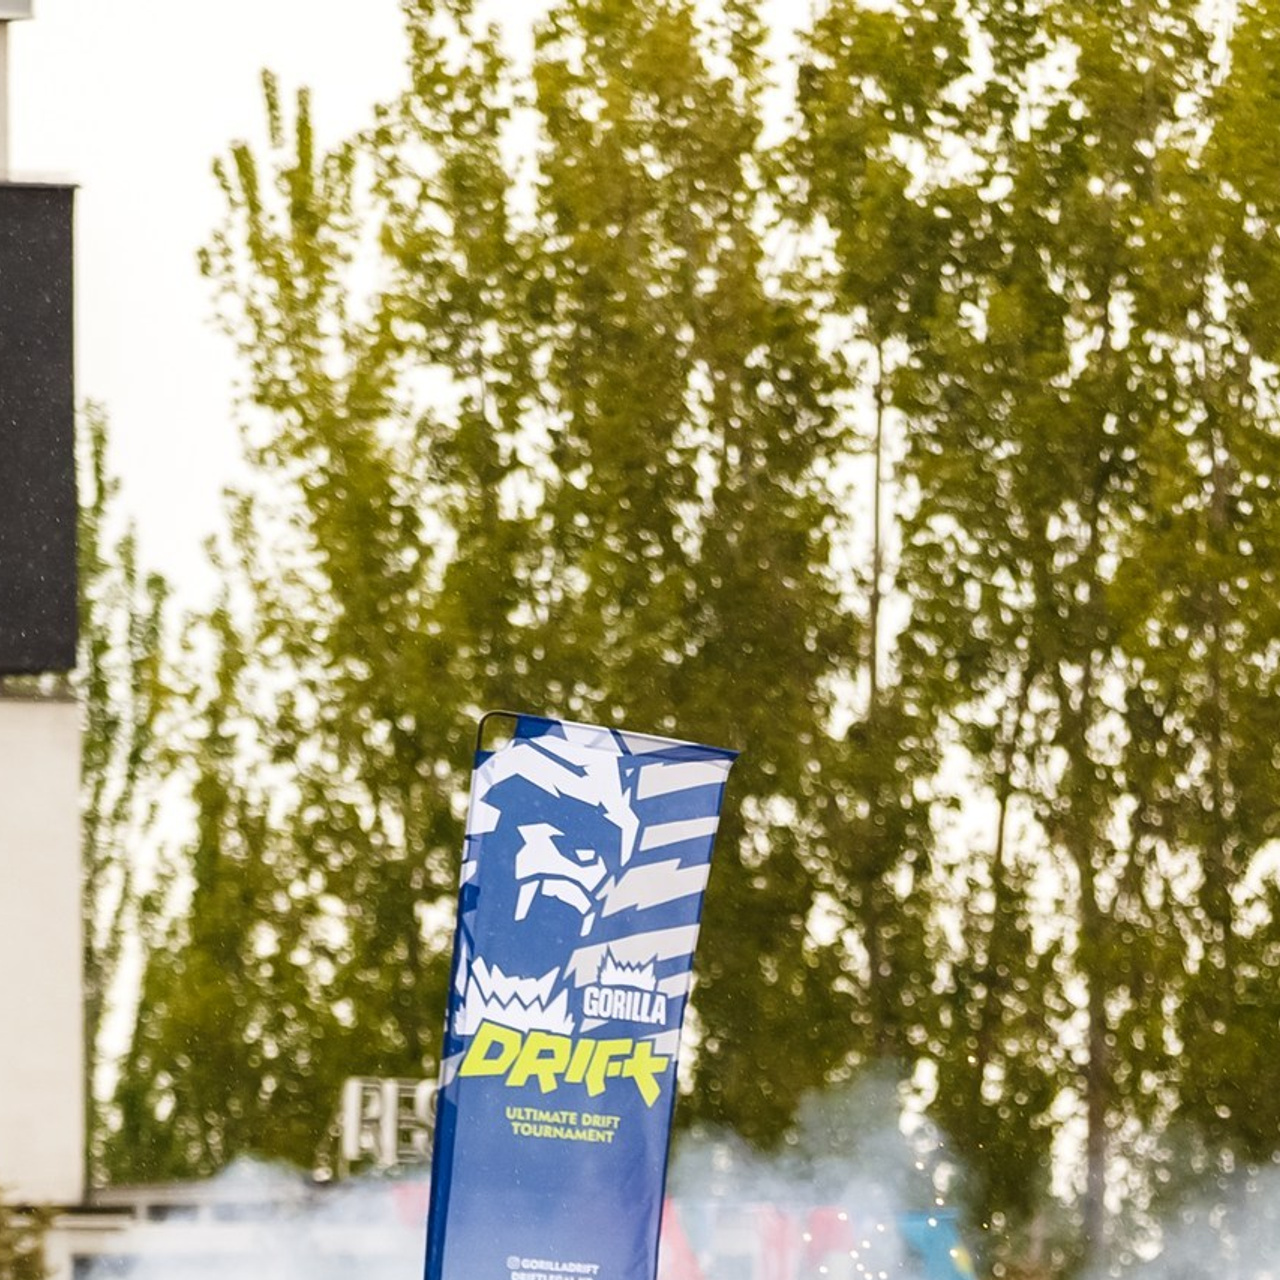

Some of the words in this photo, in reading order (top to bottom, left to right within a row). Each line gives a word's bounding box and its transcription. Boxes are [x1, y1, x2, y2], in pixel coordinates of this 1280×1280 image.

[583, 986, 667, 1025] GORILLA
[458, 1020, 669, 1108] DRIFT
[506, 1106, 577, 1126] ULTIMATE
[581, 1112, 621, 1130] DRIFT
[511, 1121, 615, 1144] TOURNAMENT
